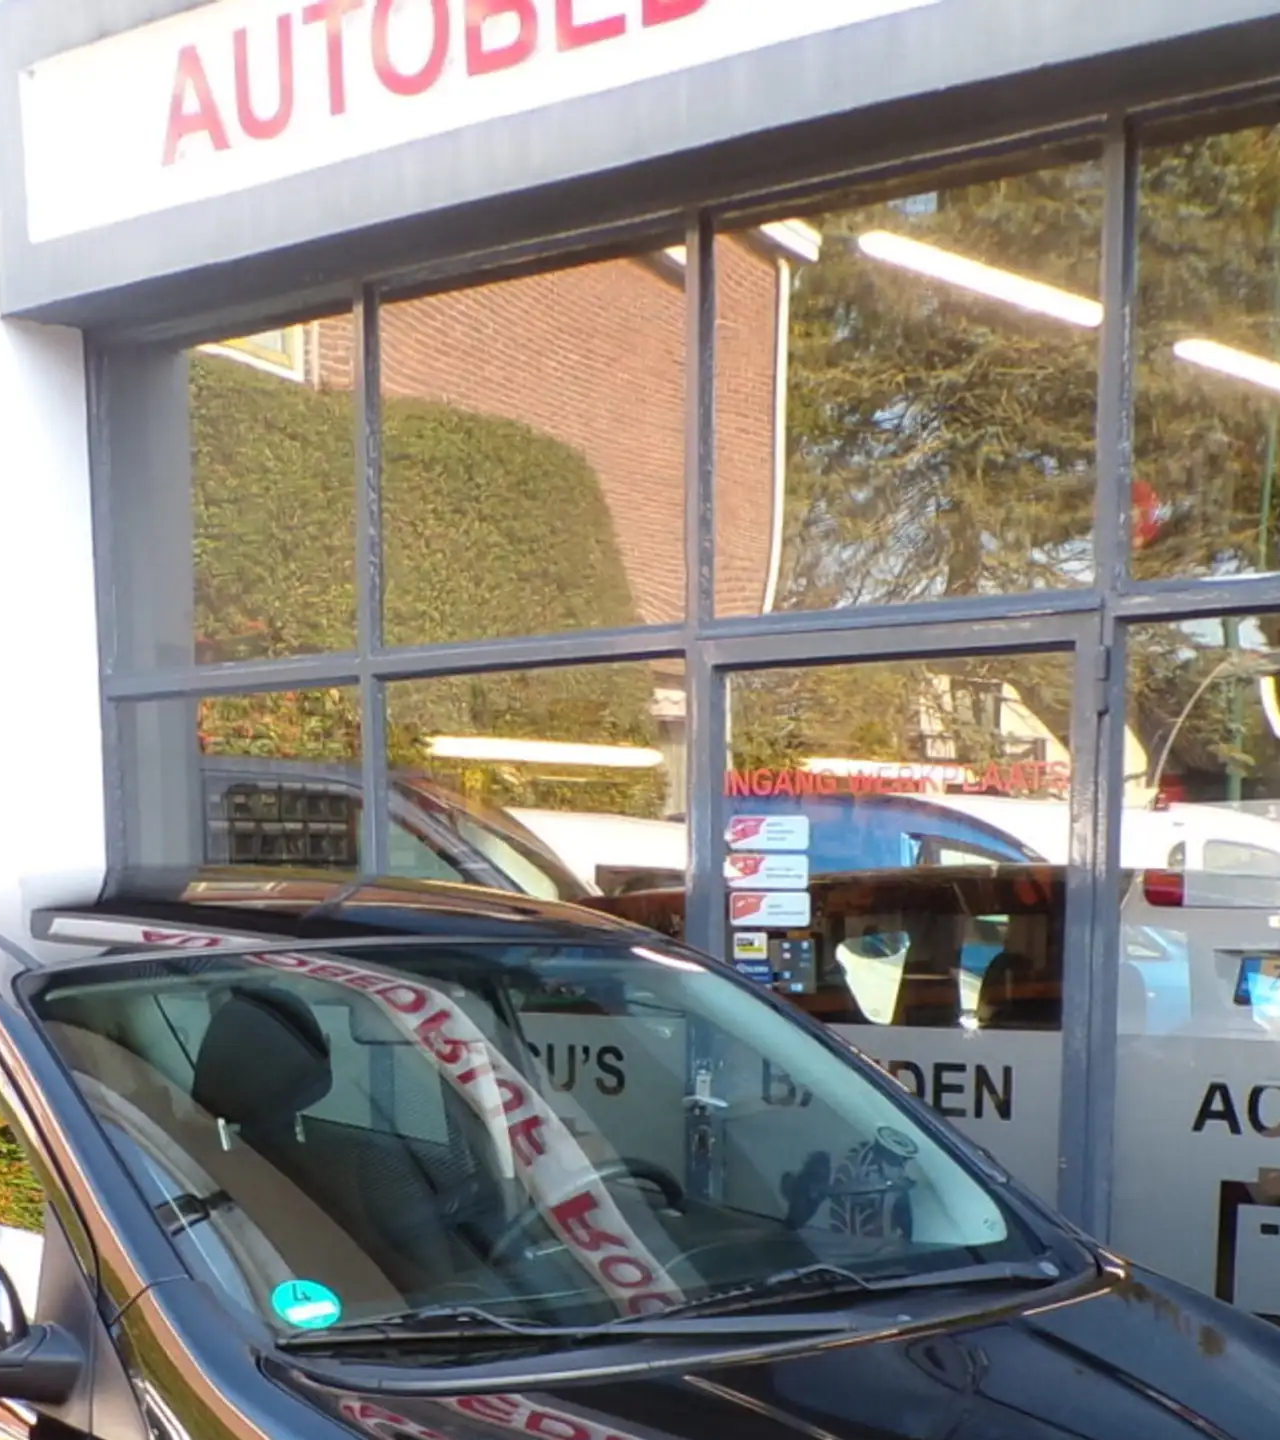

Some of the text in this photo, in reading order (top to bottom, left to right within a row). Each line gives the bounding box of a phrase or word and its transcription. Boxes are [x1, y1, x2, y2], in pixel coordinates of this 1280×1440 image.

[162, 0, 707, 167] AUTOB
[723, 759, 1071, 797] INGANG WERKPLAATS
[527, 1042, 626, 1096] U'S
